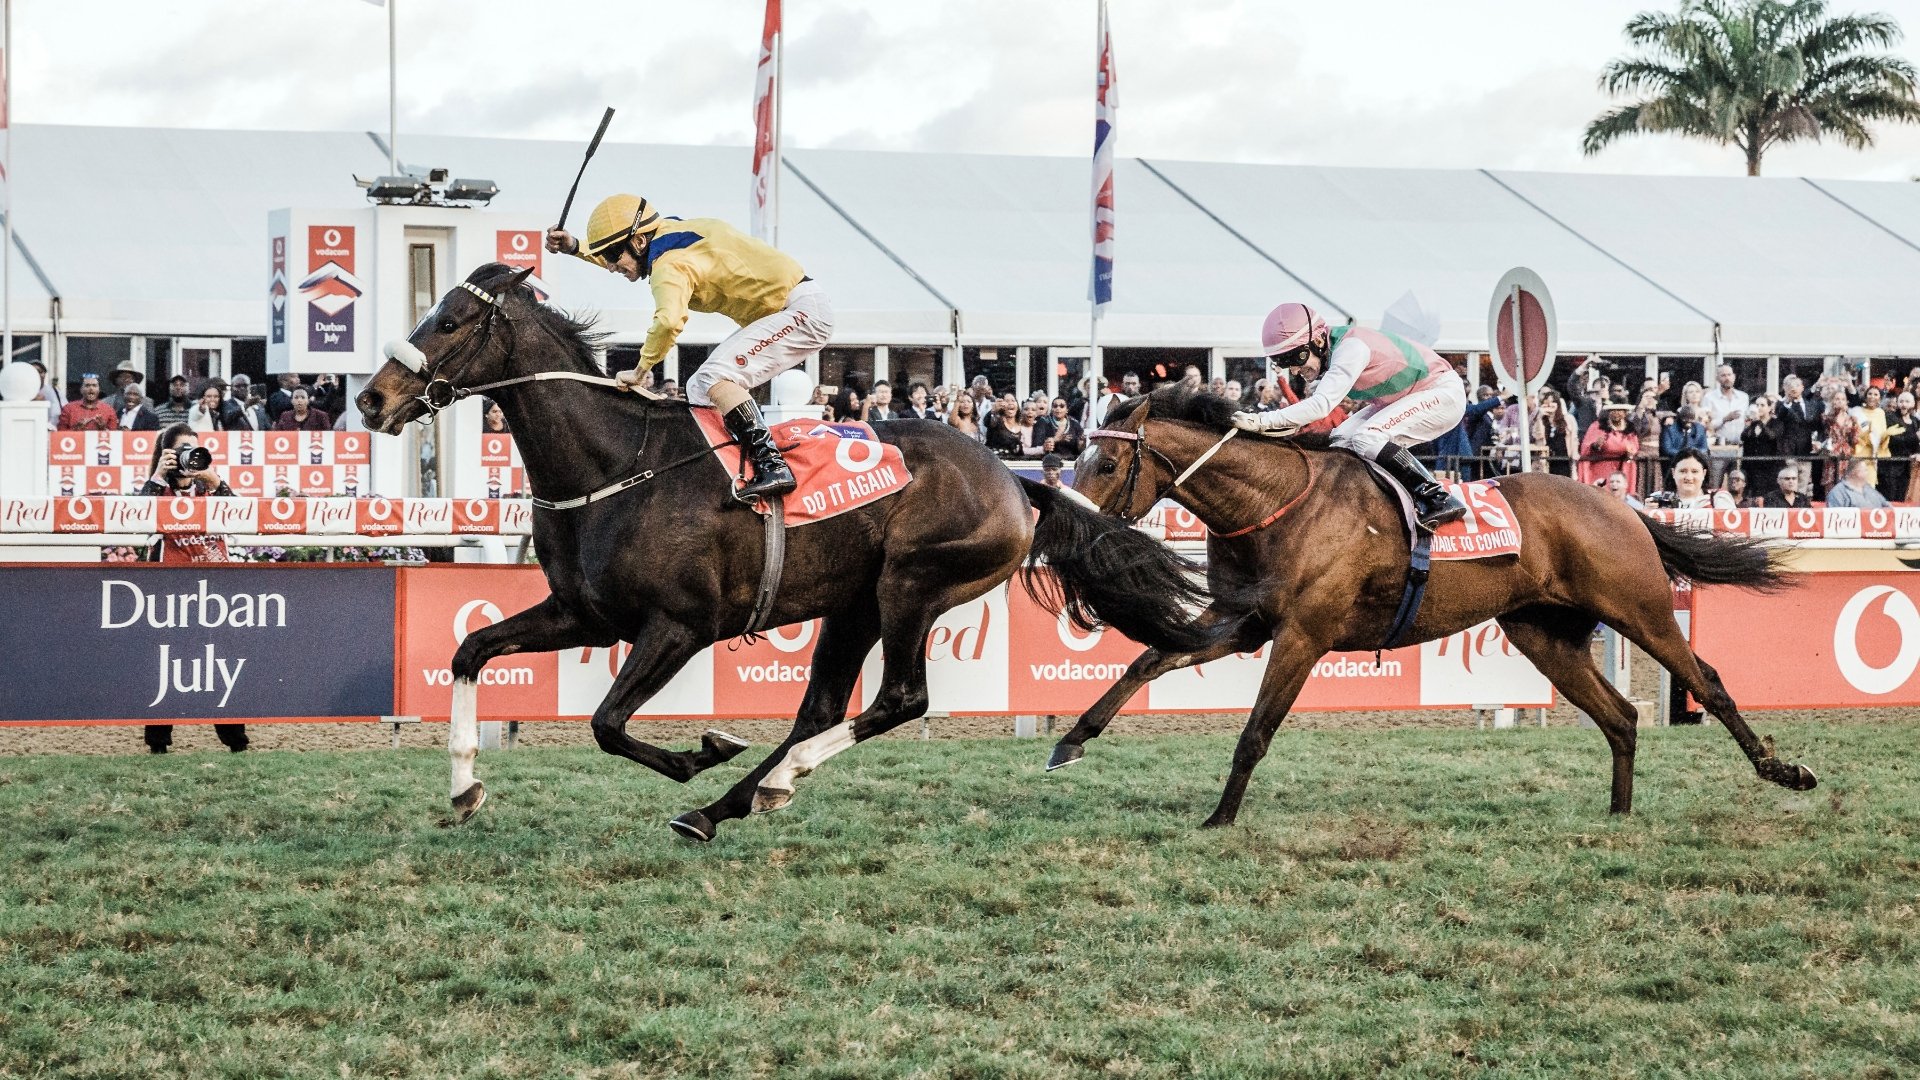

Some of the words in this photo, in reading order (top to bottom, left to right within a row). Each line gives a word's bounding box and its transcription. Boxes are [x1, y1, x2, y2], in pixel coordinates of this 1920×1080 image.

[315, 248, 350, 256] vodacom
[315, 322, 347, 332] Durban
[324, 333, 341, 344] July
[1382, 406, 1420, 431] odacom
[801, 490, 827, 515] DO
[827, 482, 845, 507] IT
[846, 465, 898, 501] AGAIN
[6, 500, 49, 527] Red
[110, 500, 152, 527] Red
[211, 501, 253, 527] Red
[311, 501, 352, 527] Red
[408, 501, 448, 528] Red
[1754, 512, 1785, 535] Red
[1827, 511, 1857, 534] Red
[59, 522, 99, 531] vodacom
[162, 522, 201, 531] vodacom
[263, 522, 301, 531] vodacom
[361, 522, 397, 532] vodacom
[458, 523, 494, 532] vodacom
[1170, 530, 1202, 538] vodacom
[1459, 535, 1475, 552] TO
[101, 579, 287, 630] Durban
[925, 599, 991, 662] ed
[148, 643, 247, 708] July
[422, 667, 534, 686] vocom
[736, 660, 812, 683] vodac
[1030, 659, 1129, 681] vodacom
